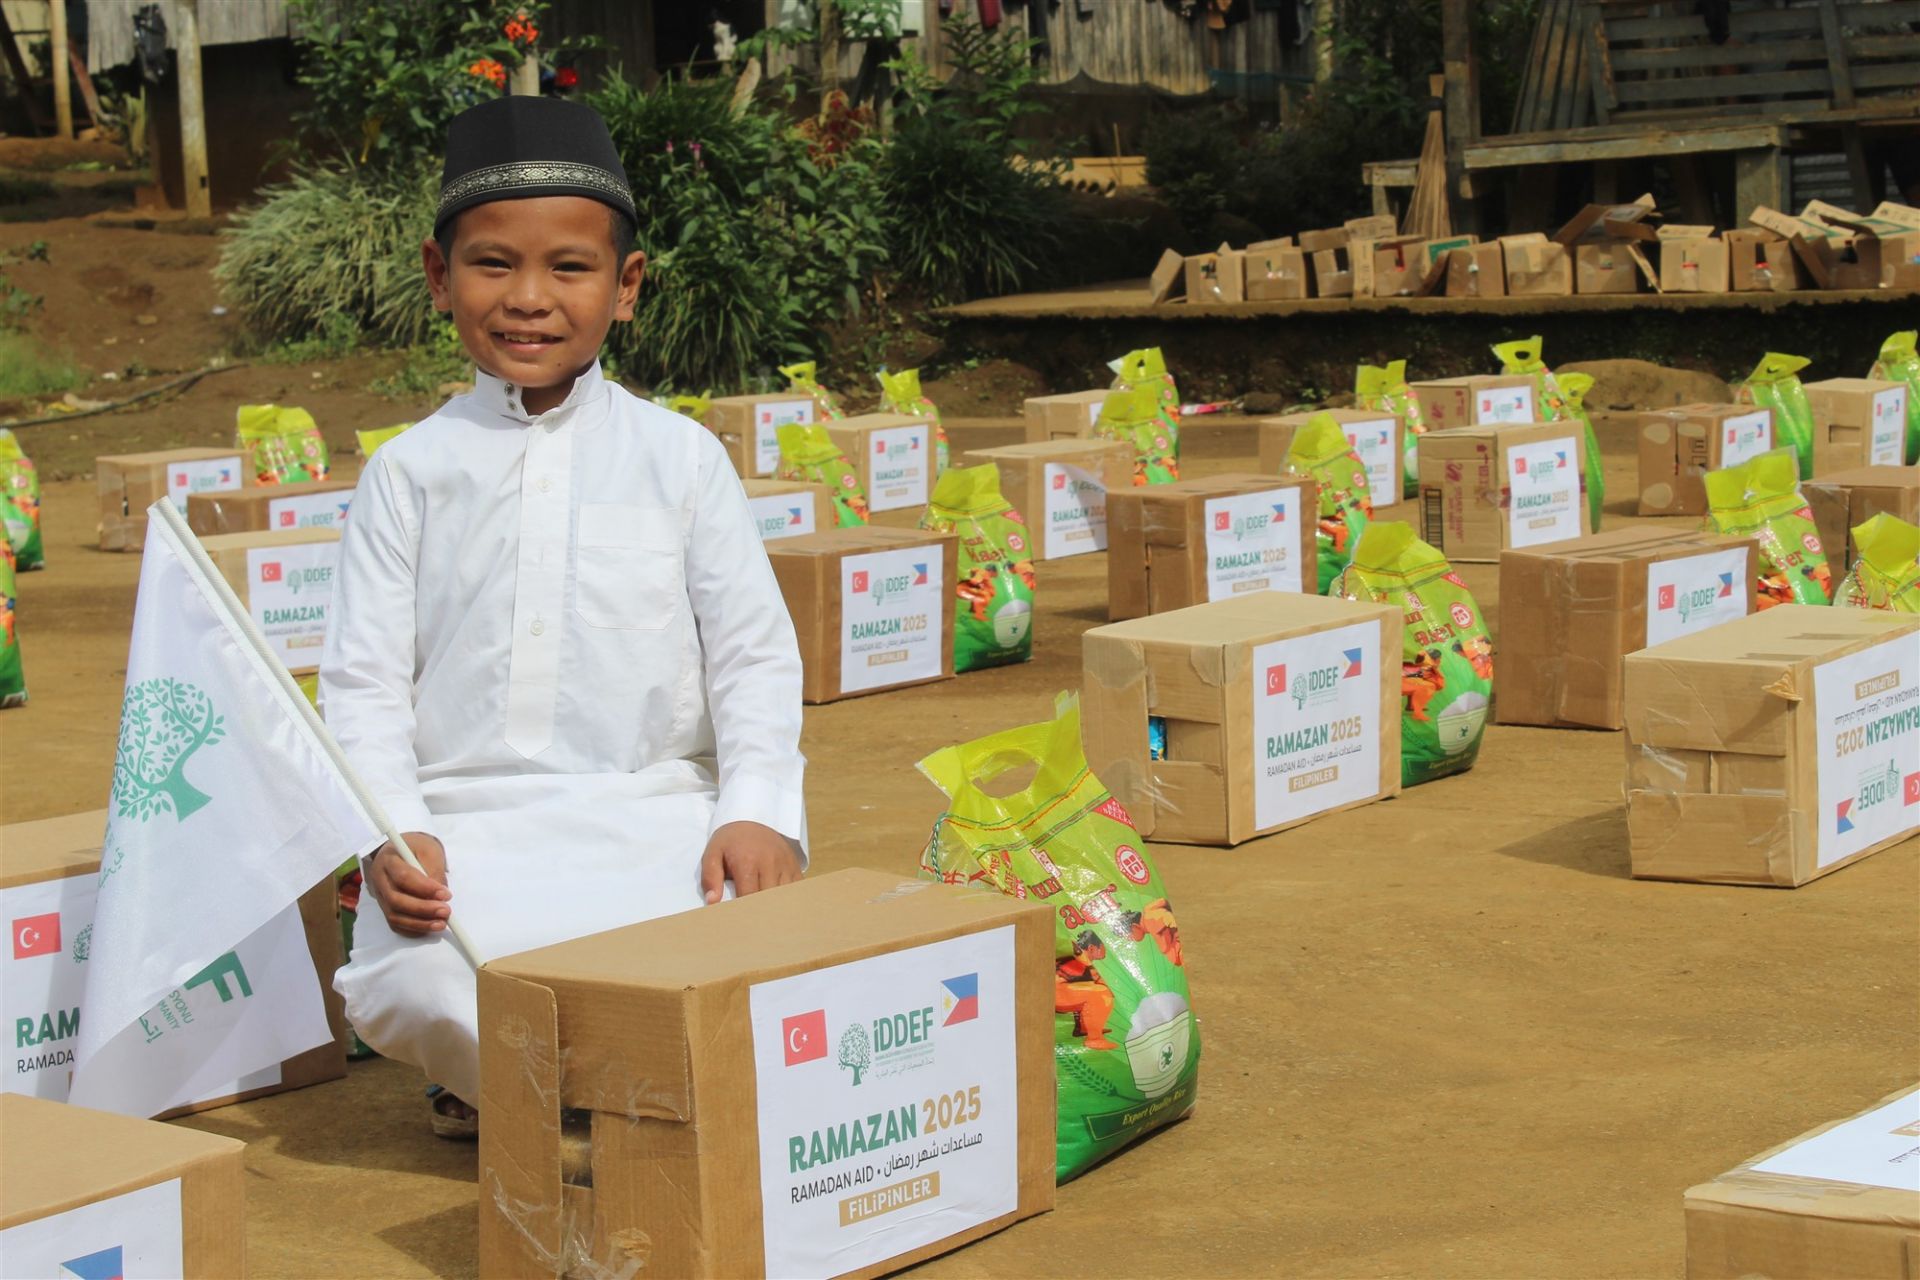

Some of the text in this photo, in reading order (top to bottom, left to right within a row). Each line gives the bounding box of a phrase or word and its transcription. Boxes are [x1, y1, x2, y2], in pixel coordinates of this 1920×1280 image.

[1215, 547, 1288, 570] RAMAZAN 2025
[263, 604, 325, 624] RAMAZAN
[851, 613, 928, 641] RAMAZAN 2025
[1267, 716, 1362, 759] RAMAZAN 2025
[1835, 705, 1920, 758] RAMAZAN 2025
[788, 1085, 982, 1174] RAMAZAN 2025
[883, 1132, 983, 1178] مساعدات شهر رمضان
[791, 1165, 874, 1204] RAMADAN AID
